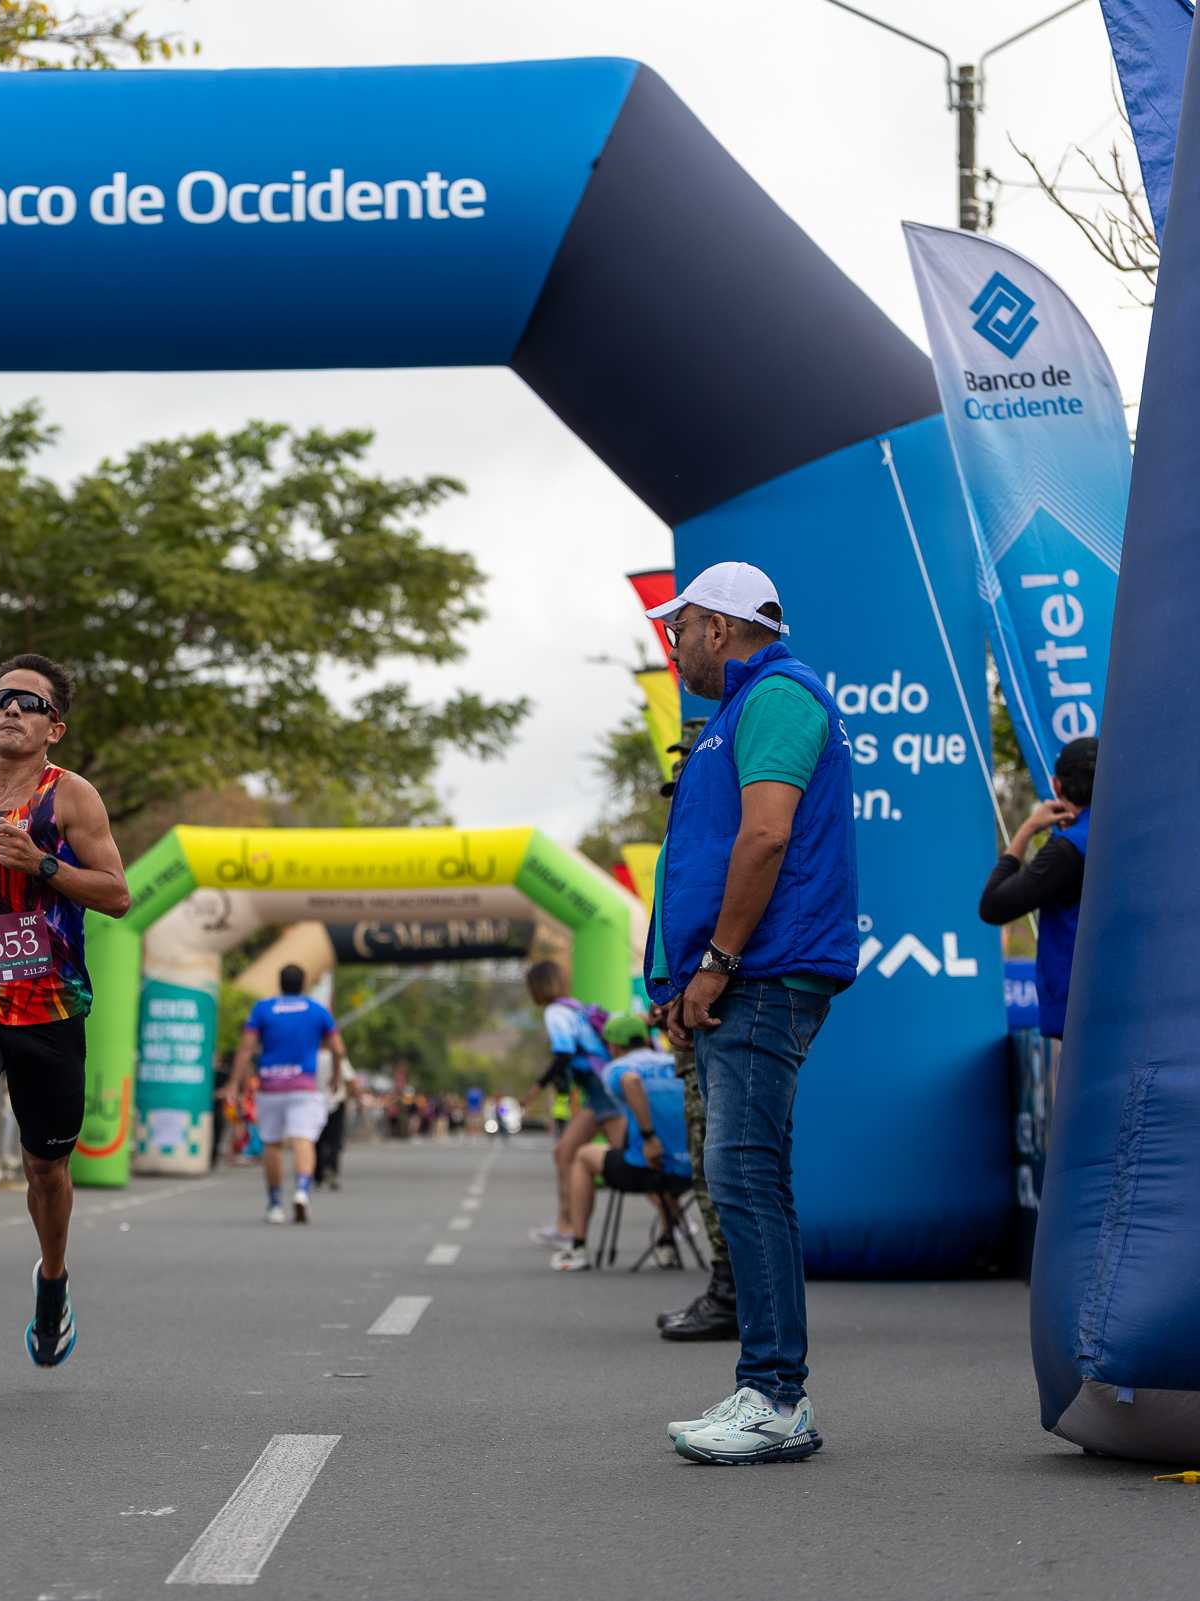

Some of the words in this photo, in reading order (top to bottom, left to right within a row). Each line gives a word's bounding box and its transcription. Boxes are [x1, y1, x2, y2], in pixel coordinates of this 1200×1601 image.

[90, 171, 164, 226] de
[177, 167, 487, 225] Occidente
[963, 370, 1036, 392] Banco
[1041, 364, 1072, 387] de
[963, 396, 1084, 421] Occidente
[1020, 569, 1097, 744] erte!
[892, 733, 967, 776] que
[19, 915, 37, 927] 10K
